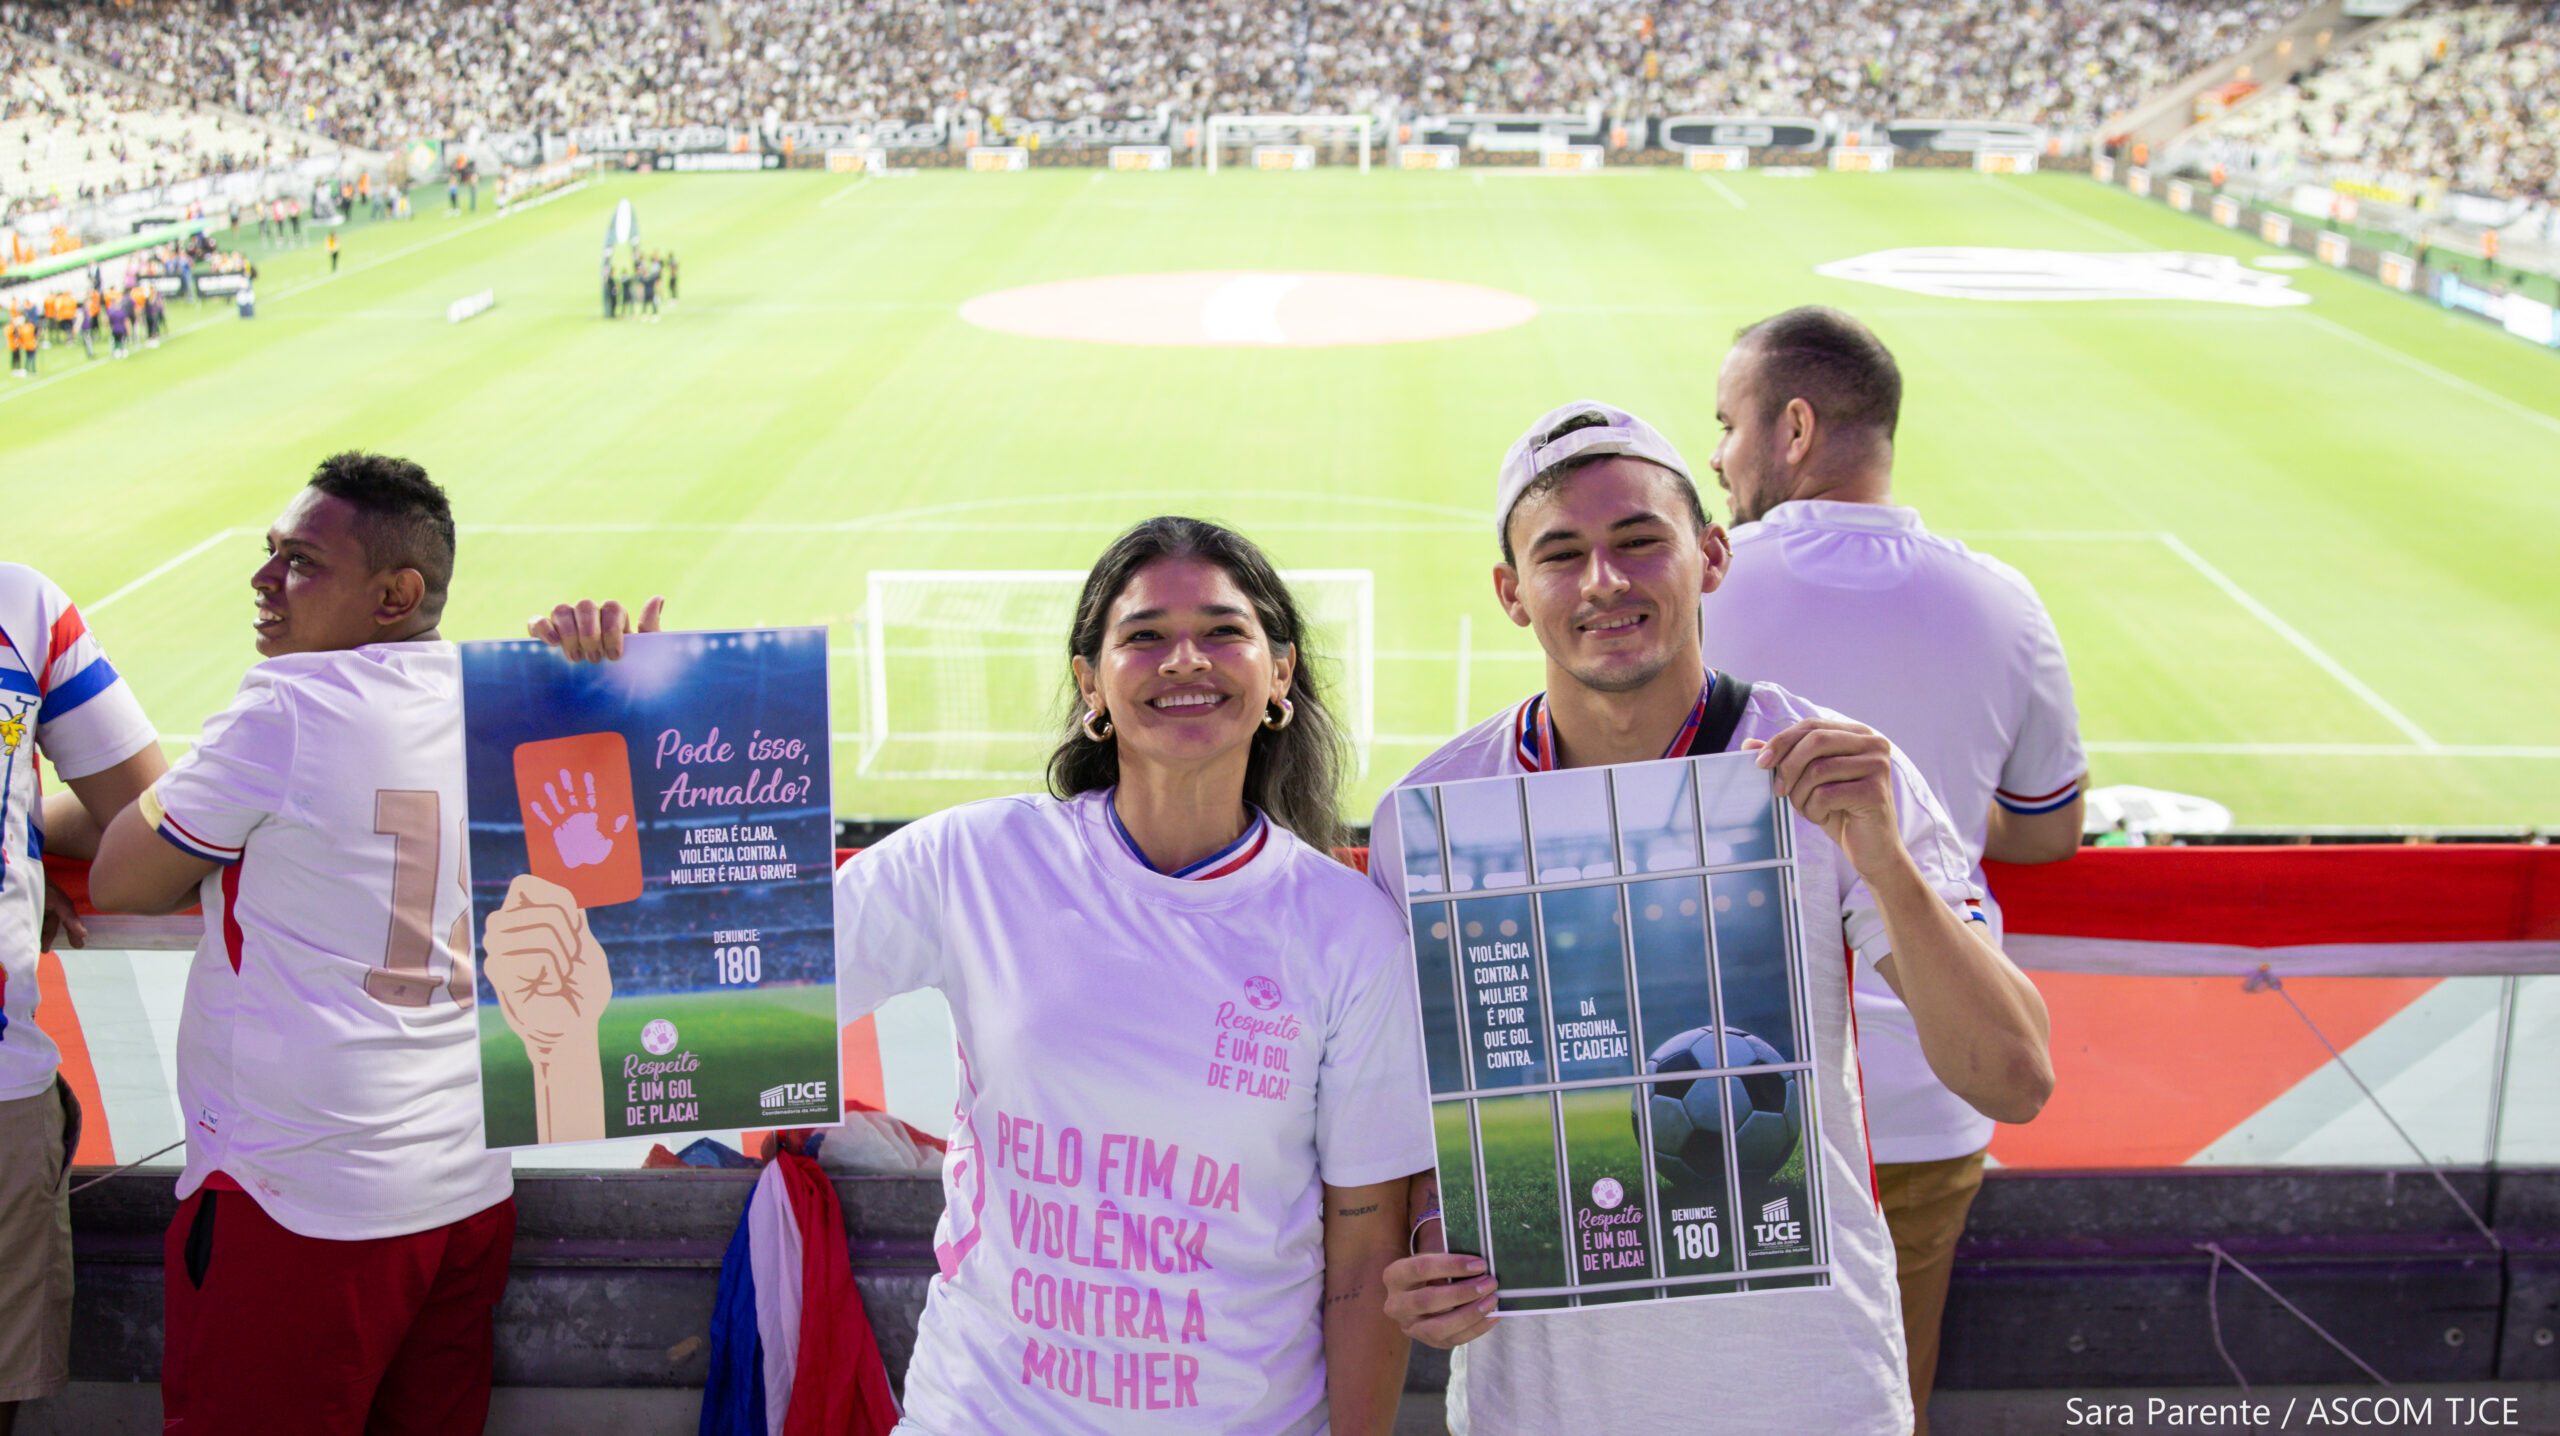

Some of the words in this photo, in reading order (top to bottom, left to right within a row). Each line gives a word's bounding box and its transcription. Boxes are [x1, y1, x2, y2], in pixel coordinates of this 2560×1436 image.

[656, 727, 735, 769] Pode
[748, 729, 809, 765] isso,
[660, 767, 811, 813] Arnaldo?
[684, 830, 692, 845] A
[694, 828, 729, 844] REGRA
[731, 825, 738, 842] É
[741, 825, 777, 841] CLARA.
[679, 846, 734, 865] VIOLÊNCIA
[737, 845, 778, 862] CONTRA
[779, 844, 787, 860] A
[671, 868, 716, 885] MULHER
[718, 864, 726, 882] É
[728, 865, 758, 881] FALTA
[760, 863, 797, 880] GRAVE!
[364, 789, 475, 1010] 1
[714, 929, 760, 944] DENUNCIE:
[1468, 942, 1530, 963] VIOLÊNCIA
[714, 945, 761, 984] 180
[1474, 964, 1517, 984] CONTRA
[1521, 964, 1529, 980] A
[1479, 985, 1528, 1006] MULHER
[1580, 997, 1596, 1017] DÁ
[1215, 1001, 1301, 1041] Respeito
[1487, 1007, 1496, 1026] É
[1498, 1007, 1525, 1025] PIOR
[1484, 1030, 1507, 1049] QUE
[1509, 1028, 1533, 1046] GOL
[1557, 1019, 1626, 1040] VERGONHA...
[1215, 1031, 1228, 1058] É
[1232, 1038, 1259, 1066] UM
[1263, 1045, 1290, 1073] GOL
[1487, 1049, 1534, 1069] CONTRA.
[1560, 1042, 1570, 1062] E
[1573, 1037, 1628, 1061] CADEIA!
[623, 1050, 700, 1081] Respeito
[627, 1080, 638, 1103] É
[641, 1080, 664, 1101] UM
[668, 1079, 697, 1100] GOL
[783, 1081, 827, 1100] TJCE
[1207, 1062, 1232, 1090] DE
[1236, 1068, 1290, 1101] PLACA!
[626, 1105, 646, 1126] DE
[650, 1101, 699, 1124] PLACA!
[998, 1110, 1082, 1188] PELO
[1098, 1133, 1179, 1200] FIM
[1188, 1153, 1240, 1213] DA
[1578, 1204, 1643, 1232] Respeito
[1671, 1206, 1718, 1222] DENUNCIE:
[1009, 1188, 1214, 1275] VIOLÊNCIA
[1583, 1230, 1592, 1250] É
[1594, 1231, 1615, 1250] UM
[1617, 1229, 1642, 1248] GOL
[1673, 1222, 1720, 1260] 180
[1753, 1221, 1802, 1243] TJCE
[1583, 1253, 1600, 1271] DE
[1602, 1249, 1645, 1270] PLACA!
[1011, 1267, 1169, 1344] CONTRA
[1181, 1288, 1207, 1345] A
[1022, 1336, 1199, 1411] MULHER
